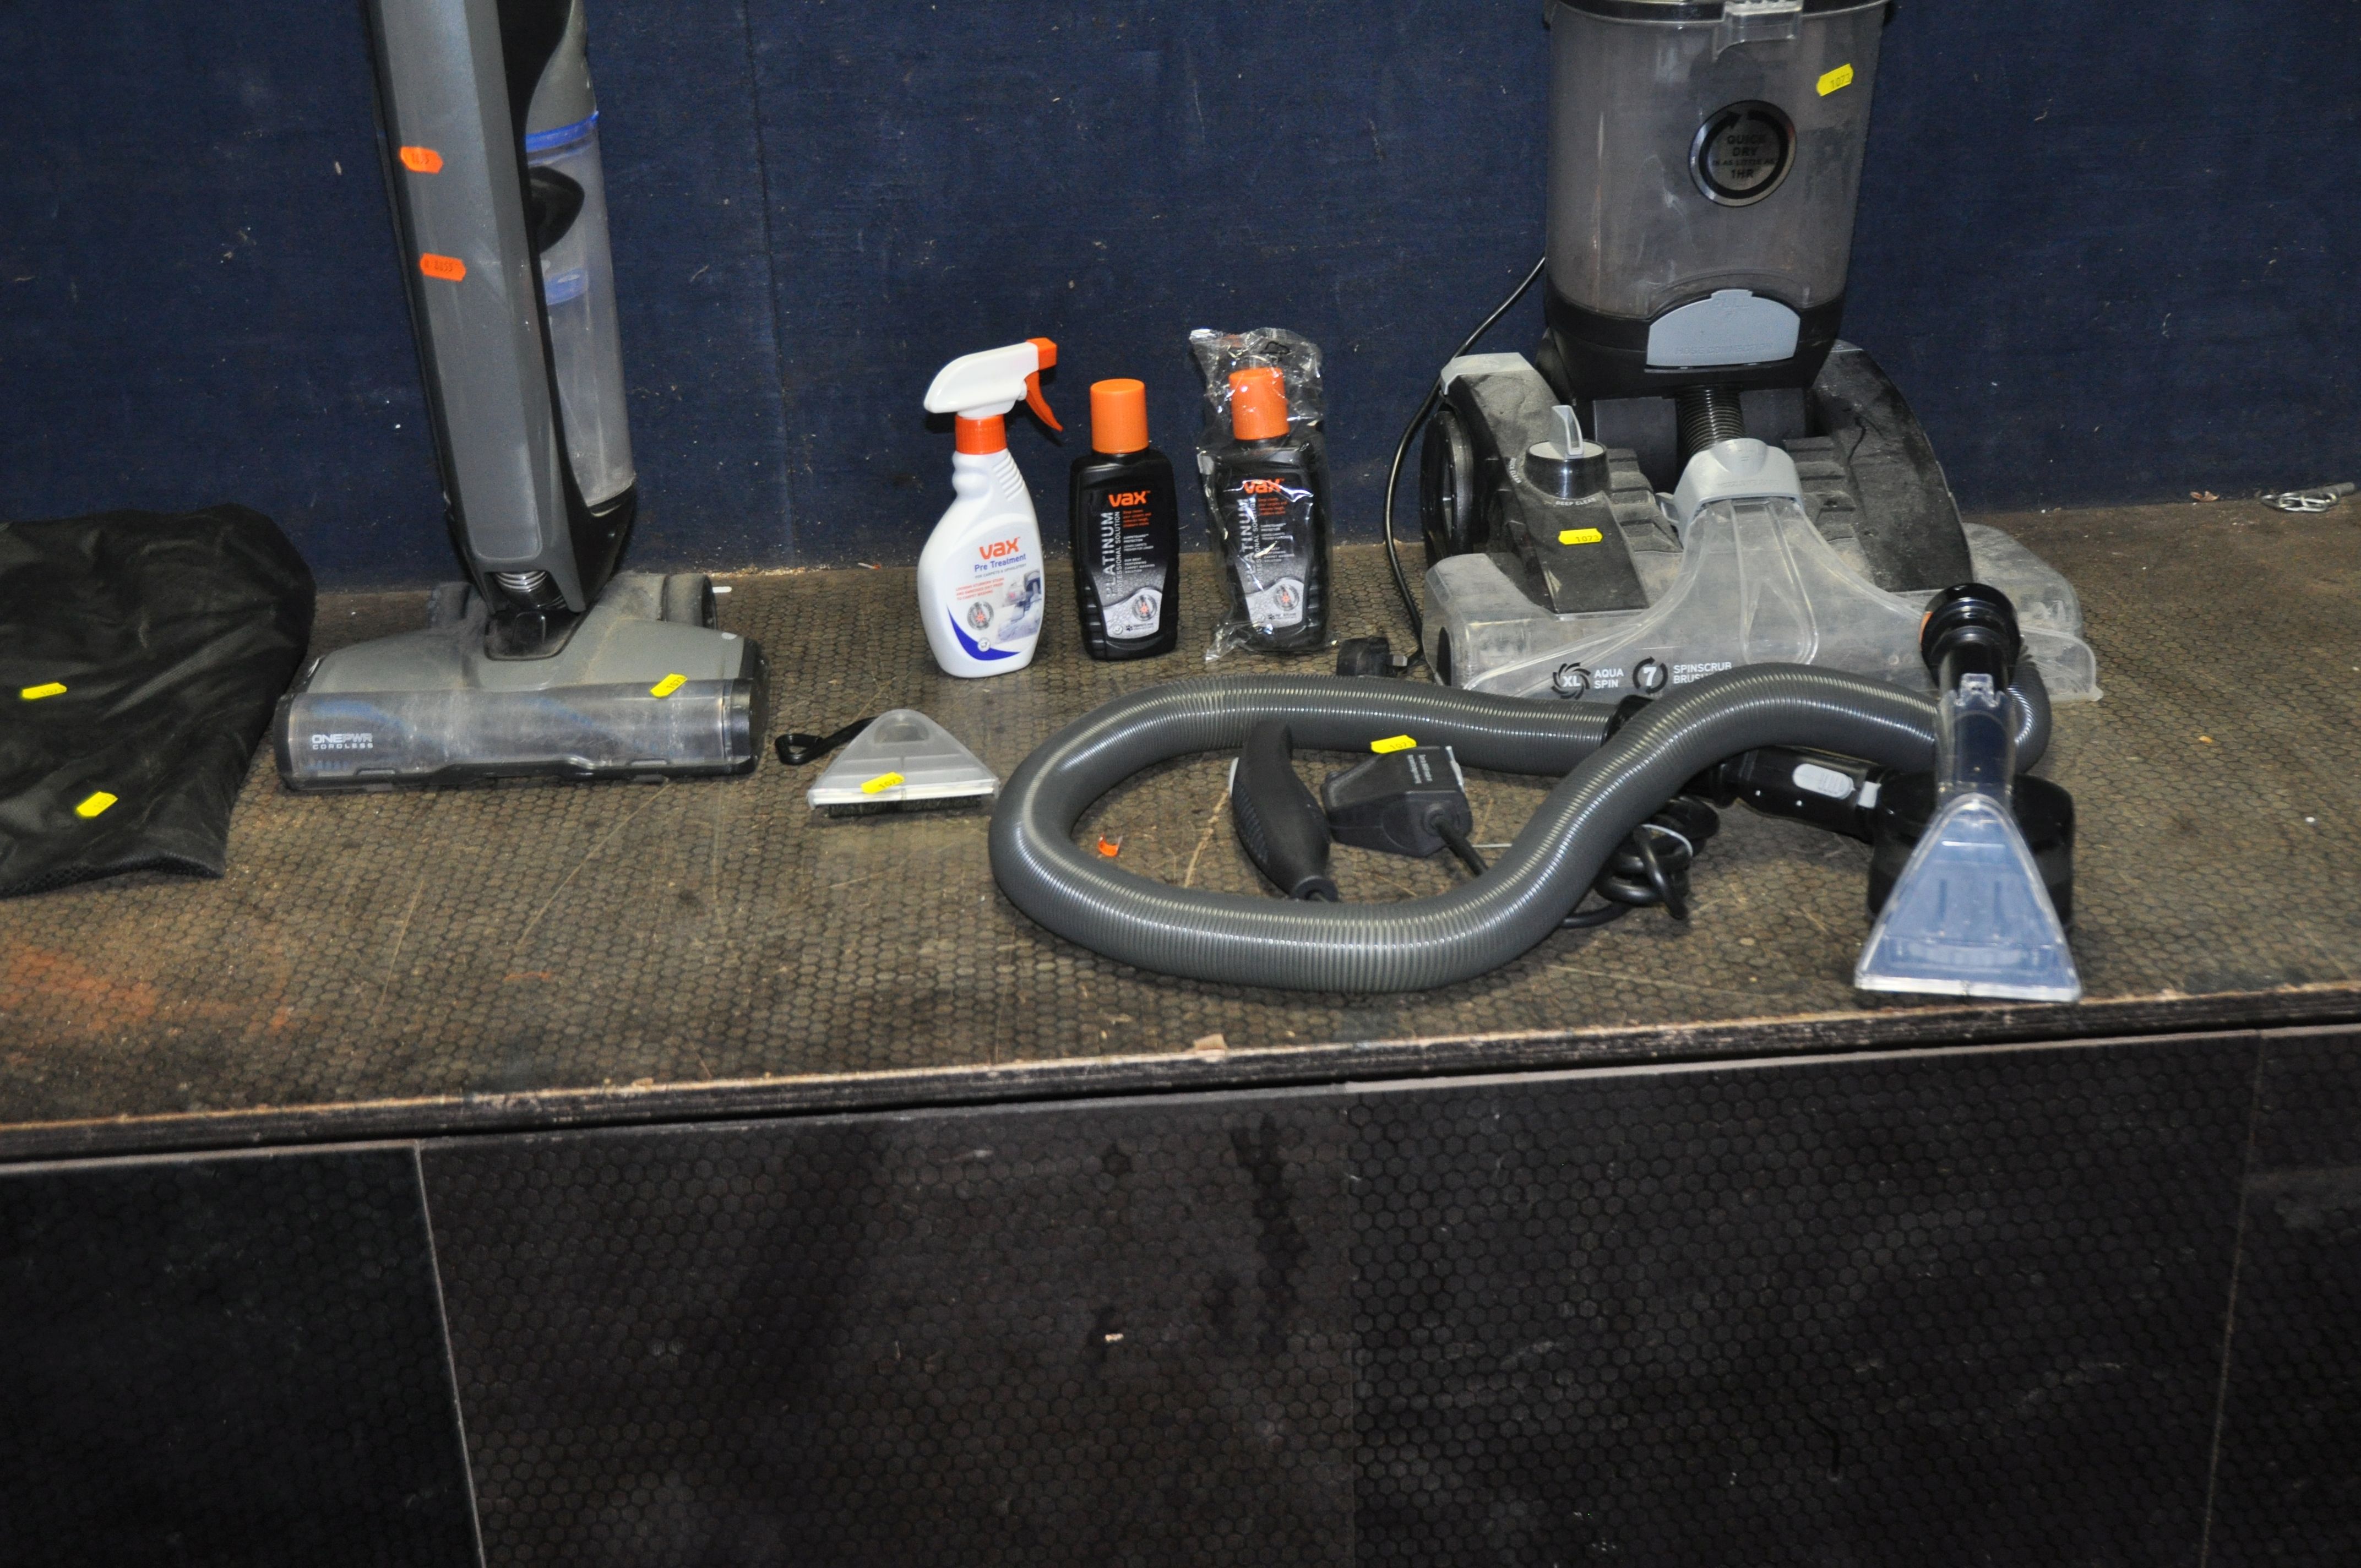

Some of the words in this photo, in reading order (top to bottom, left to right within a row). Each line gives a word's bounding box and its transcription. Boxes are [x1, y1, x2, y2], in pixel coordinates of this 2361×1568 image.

[1726, 134, 1766, 145] QUICK
[1732, 146, 1758, 157] DRY
[1731, 168, 1755, 179] 1HR
[1575, 535, 1600, 543] 1073
[1100, 512, 1117, 598] PLATINUM
[974, 564, 988, 573] Pre
[990, 553, 1026, 568] Treatment
[1115, 546, 1123, 597] PROFESSIONAL
[1673, 661, 1732, 674] SPINSCRUB
[1594, 668, 1624, 679] AQUA
[1643, 666, 1657, 687] 7
[666, 676, 686, 689] 1073
[1563, 676, 1581, 688] XL
[1593, 679, 1619, 689] SPIN
[311, 733, 373, 744] ONEPWR
[1389, 741, 1416, 749] 1073
[878, 776, 903, 788] 1073
